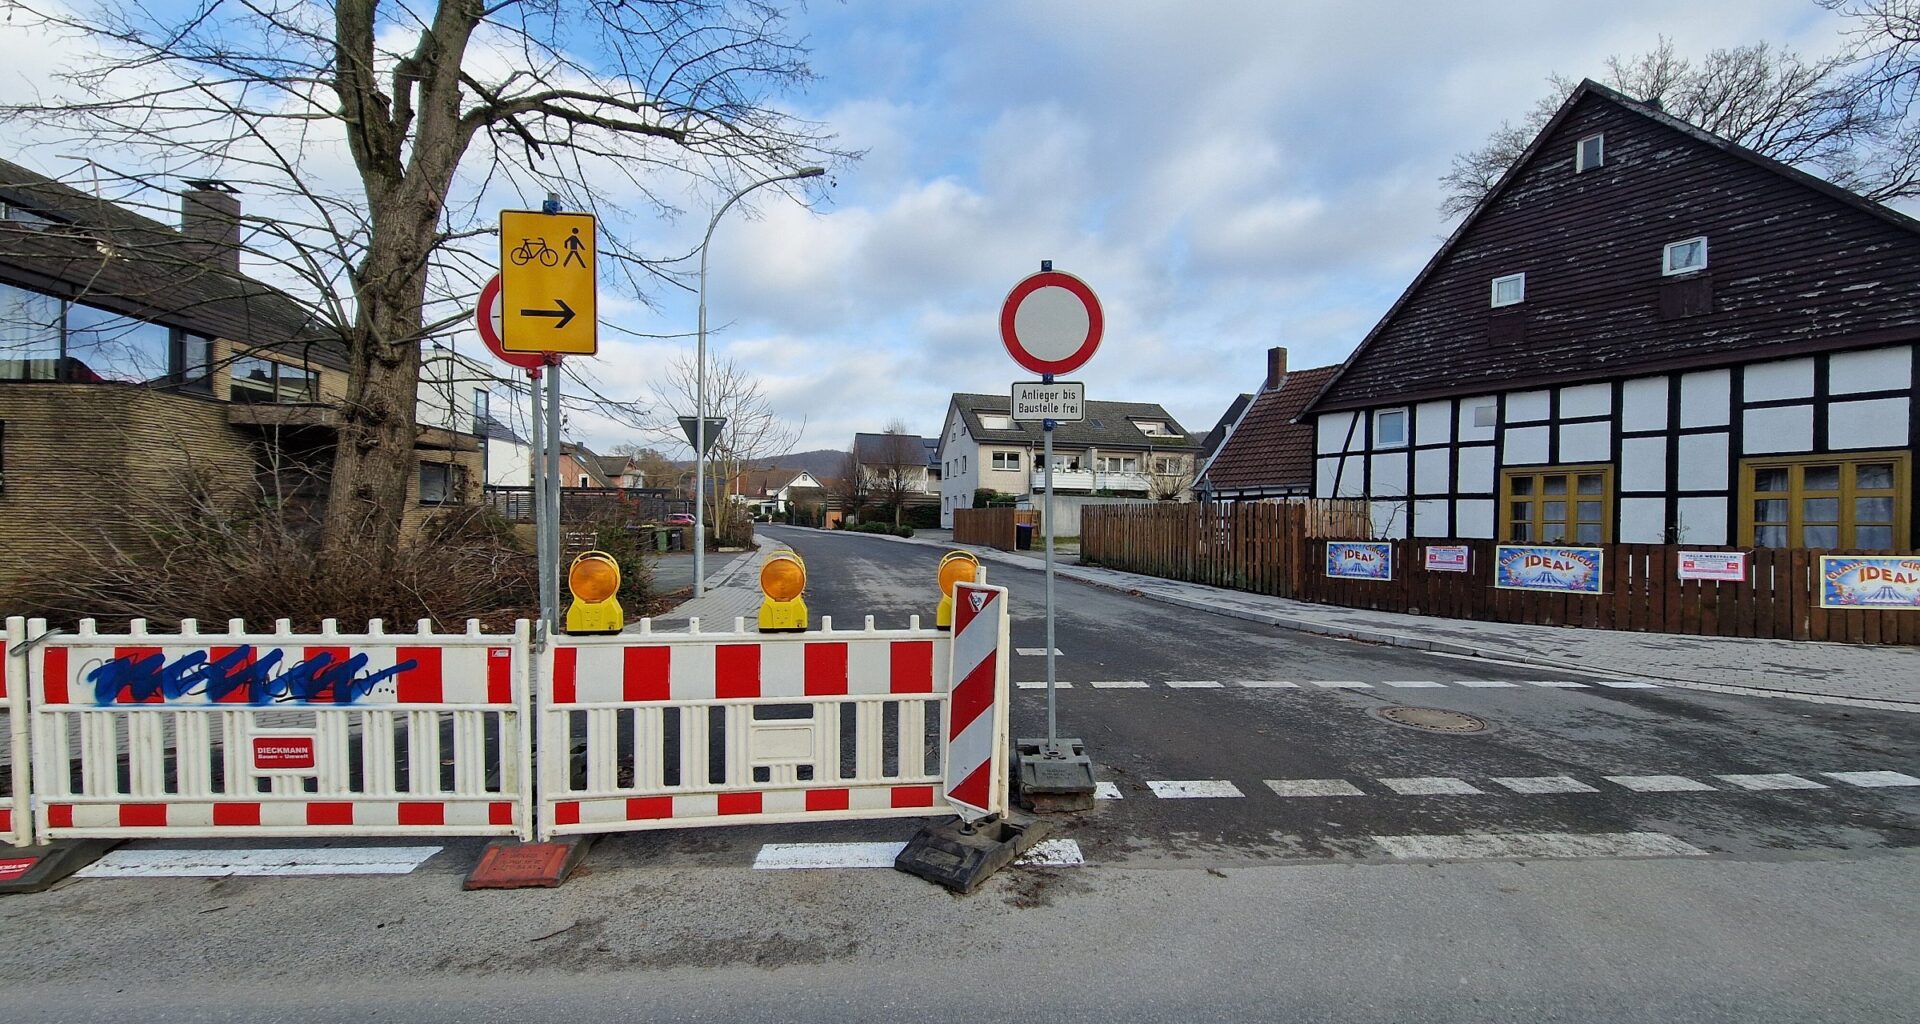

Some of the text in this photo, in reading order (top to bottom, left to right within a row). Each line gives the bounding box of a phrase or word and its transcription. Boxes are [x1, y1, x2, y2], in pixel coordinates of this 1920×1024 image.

[1021, 389, 1076, 402] Anlieger bis
[1018, 403, 1078, 413] Baustelle frei
[1344, 549, 1375, 562] IDEAL
[1559, 550, 1595, 569] CIRCUS
[1524, 555, 1575, 571] IDEAL
[1859, 566, 1918, 584] IDEAL
